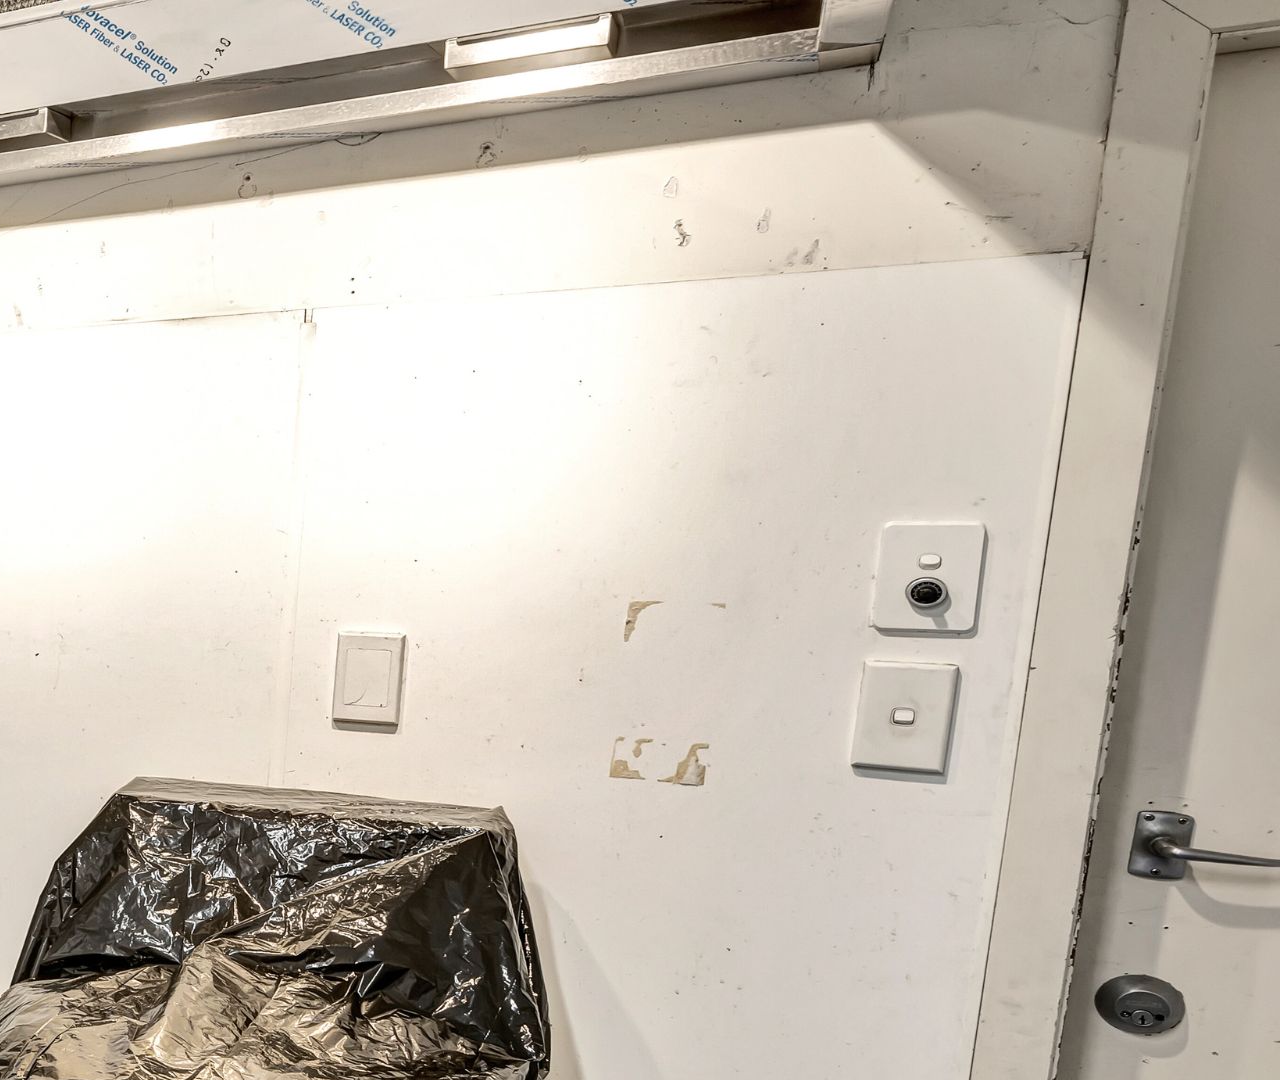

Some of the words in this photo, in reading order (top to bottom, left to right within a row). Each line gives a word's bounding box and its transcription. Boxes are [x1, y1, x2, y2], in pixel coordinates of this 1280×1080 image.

[330, 9, 365, 36] LASER
[347, 0, 396, 37] Solution
[90, 28, 115, 48] Fiber
[120, 48, 151, 73] LASER
[134, 40, 178, 75] Solution
